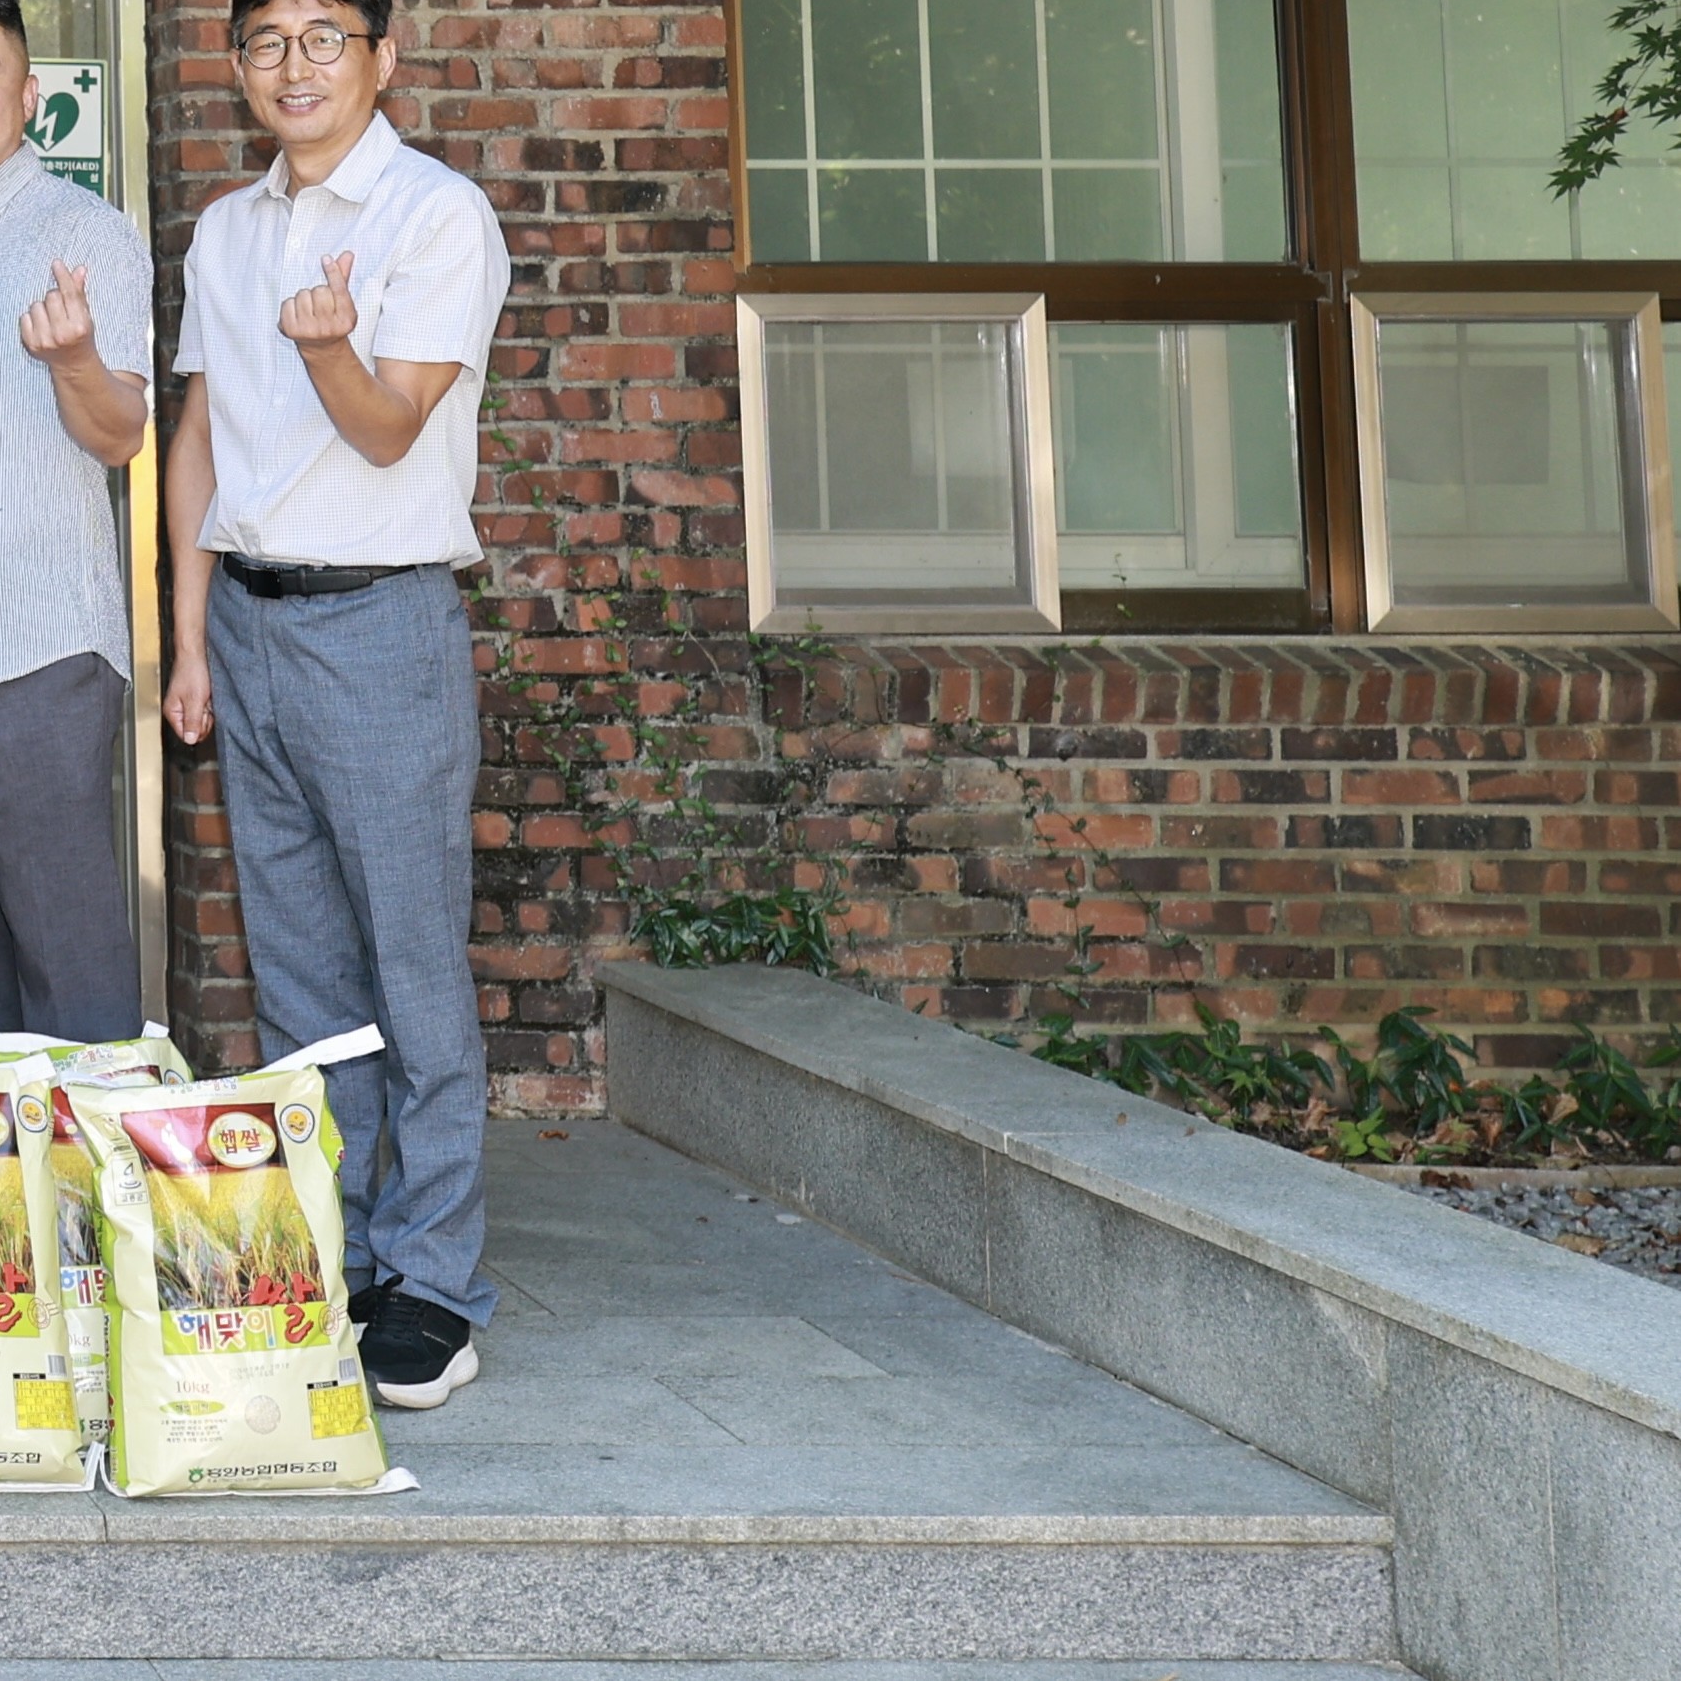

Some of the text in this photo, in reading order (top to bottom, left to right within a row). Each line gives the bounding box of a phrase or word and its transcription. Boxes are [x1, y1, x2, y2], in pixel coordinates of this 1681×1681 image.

[219, 1127, 261, 1155] 햅쌀
[177, 1310, 277, 1352] 해맞이
[175, 1380, 210, 1395] 10kg
